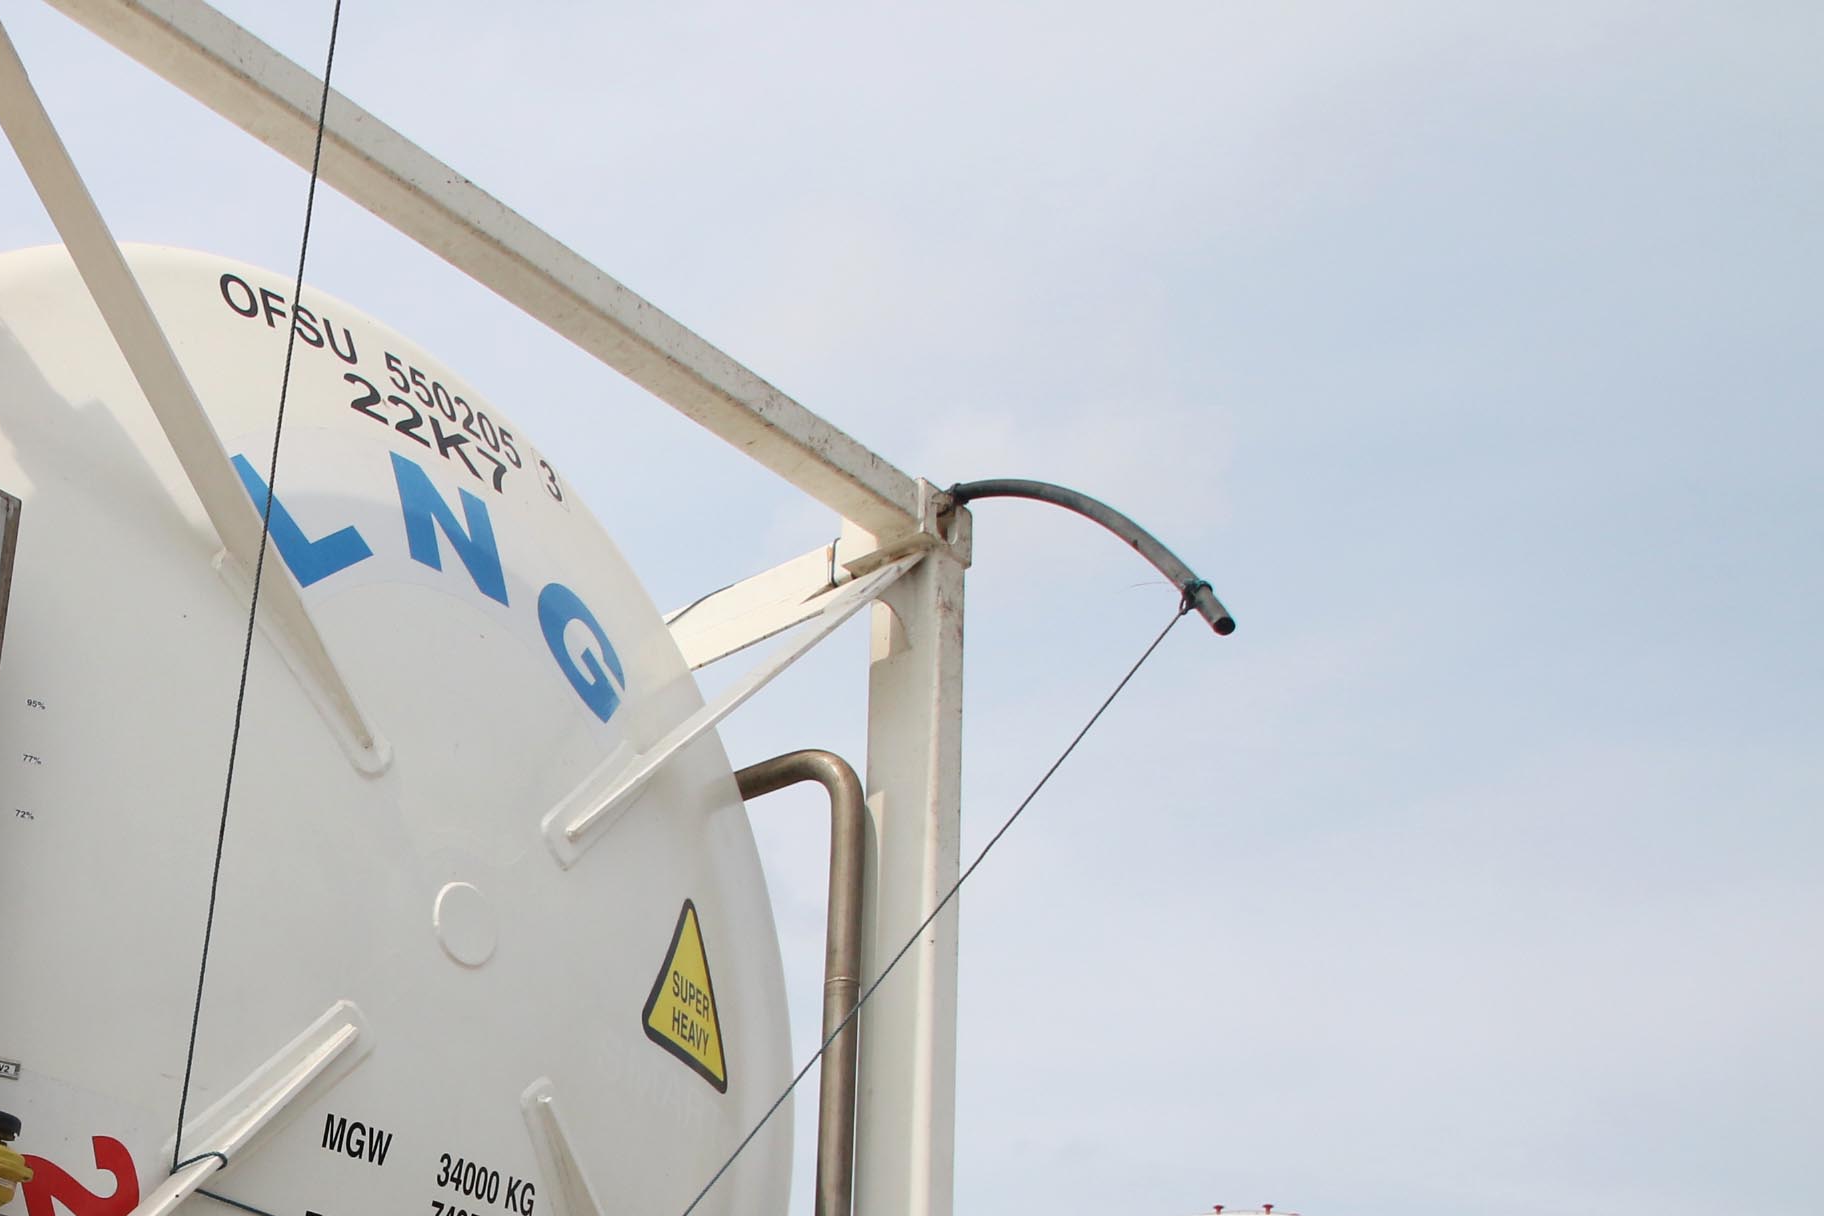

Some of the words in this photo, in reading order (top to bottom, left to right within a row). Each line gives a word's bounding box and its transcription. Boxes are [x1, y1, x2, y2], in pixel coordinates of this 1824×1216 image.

[219, 274, 358, 365] OFSU
[384, 351, 522, 469] 550205
[539, 459, 564, 502] 3
[343, 373, 508, 493] 22K7
[23, 754, 42, 765] 77%
[672, 970, 711, 1022] SUPER
[672, 1006, 710, 1056] HEAVY
[321, 1113, 393, 1166] MGW
[436, 1153, 500, 1204] 34000
[504, 1176, 536, 1216] KG
